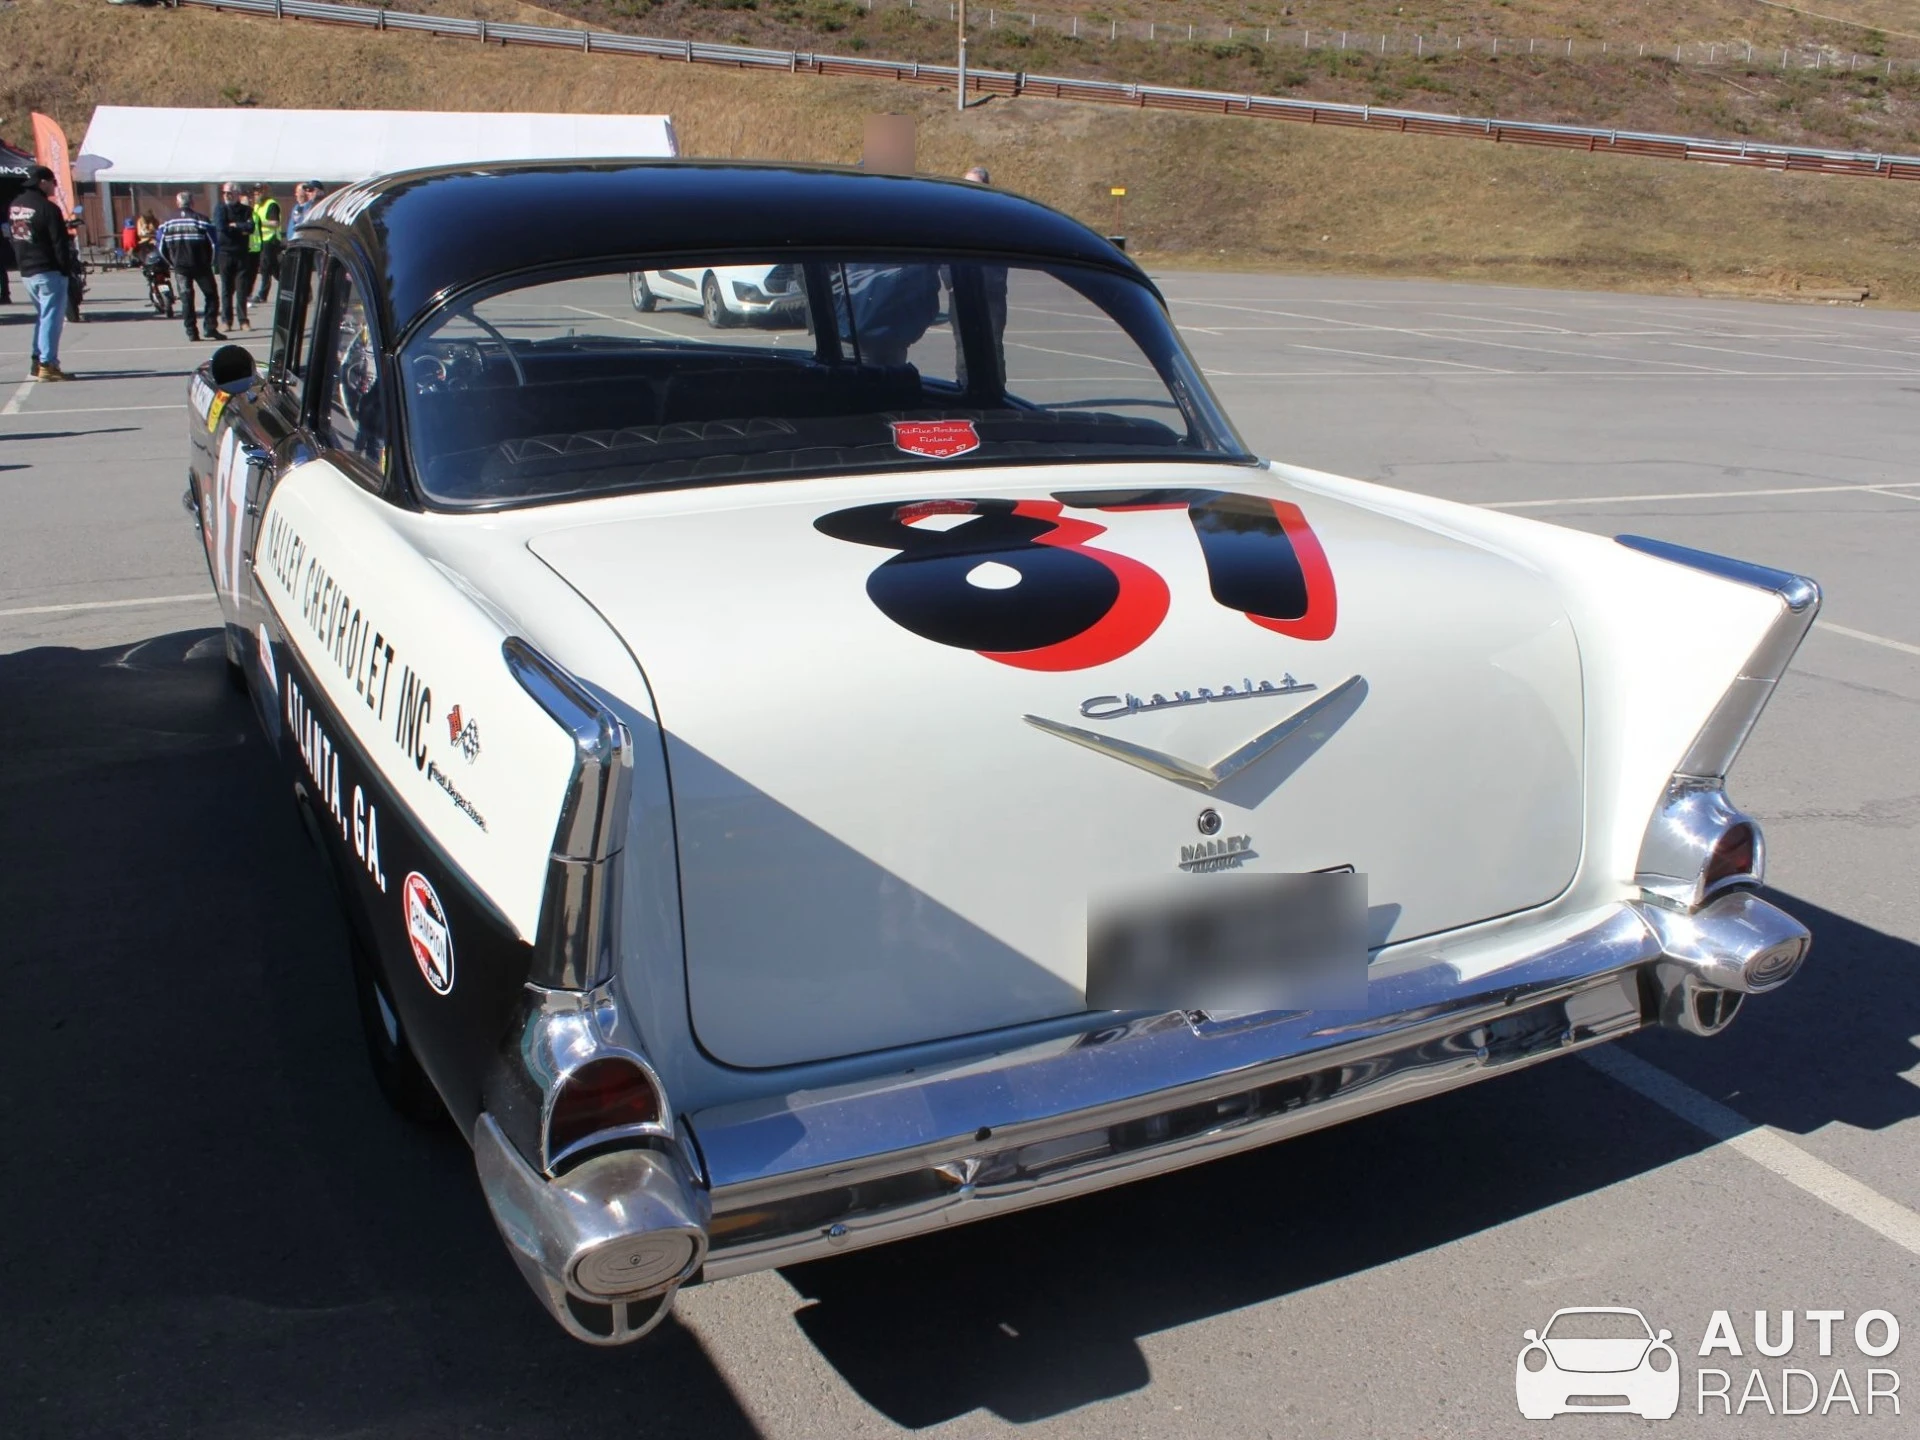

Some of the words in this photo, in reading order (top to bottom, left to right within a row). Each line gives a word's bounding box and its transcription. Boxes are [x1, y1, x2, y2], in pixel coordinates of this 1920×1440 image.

[919, 435, 956, 443] Finland
[813, 488, 1337, 672] 87
[268, 509, 306, 600] NALLEY
[303, 556, 395, 721] CHEVROLET
[1079, 672, 1318, 720] Chevrolet
[287, 672, 347, 841] ATLANTA,
[353, 784, 386, 893] GA.
[1179, 834, 1252, 862] NALLEY
[410, 899, 446, 966] CHAMPION
